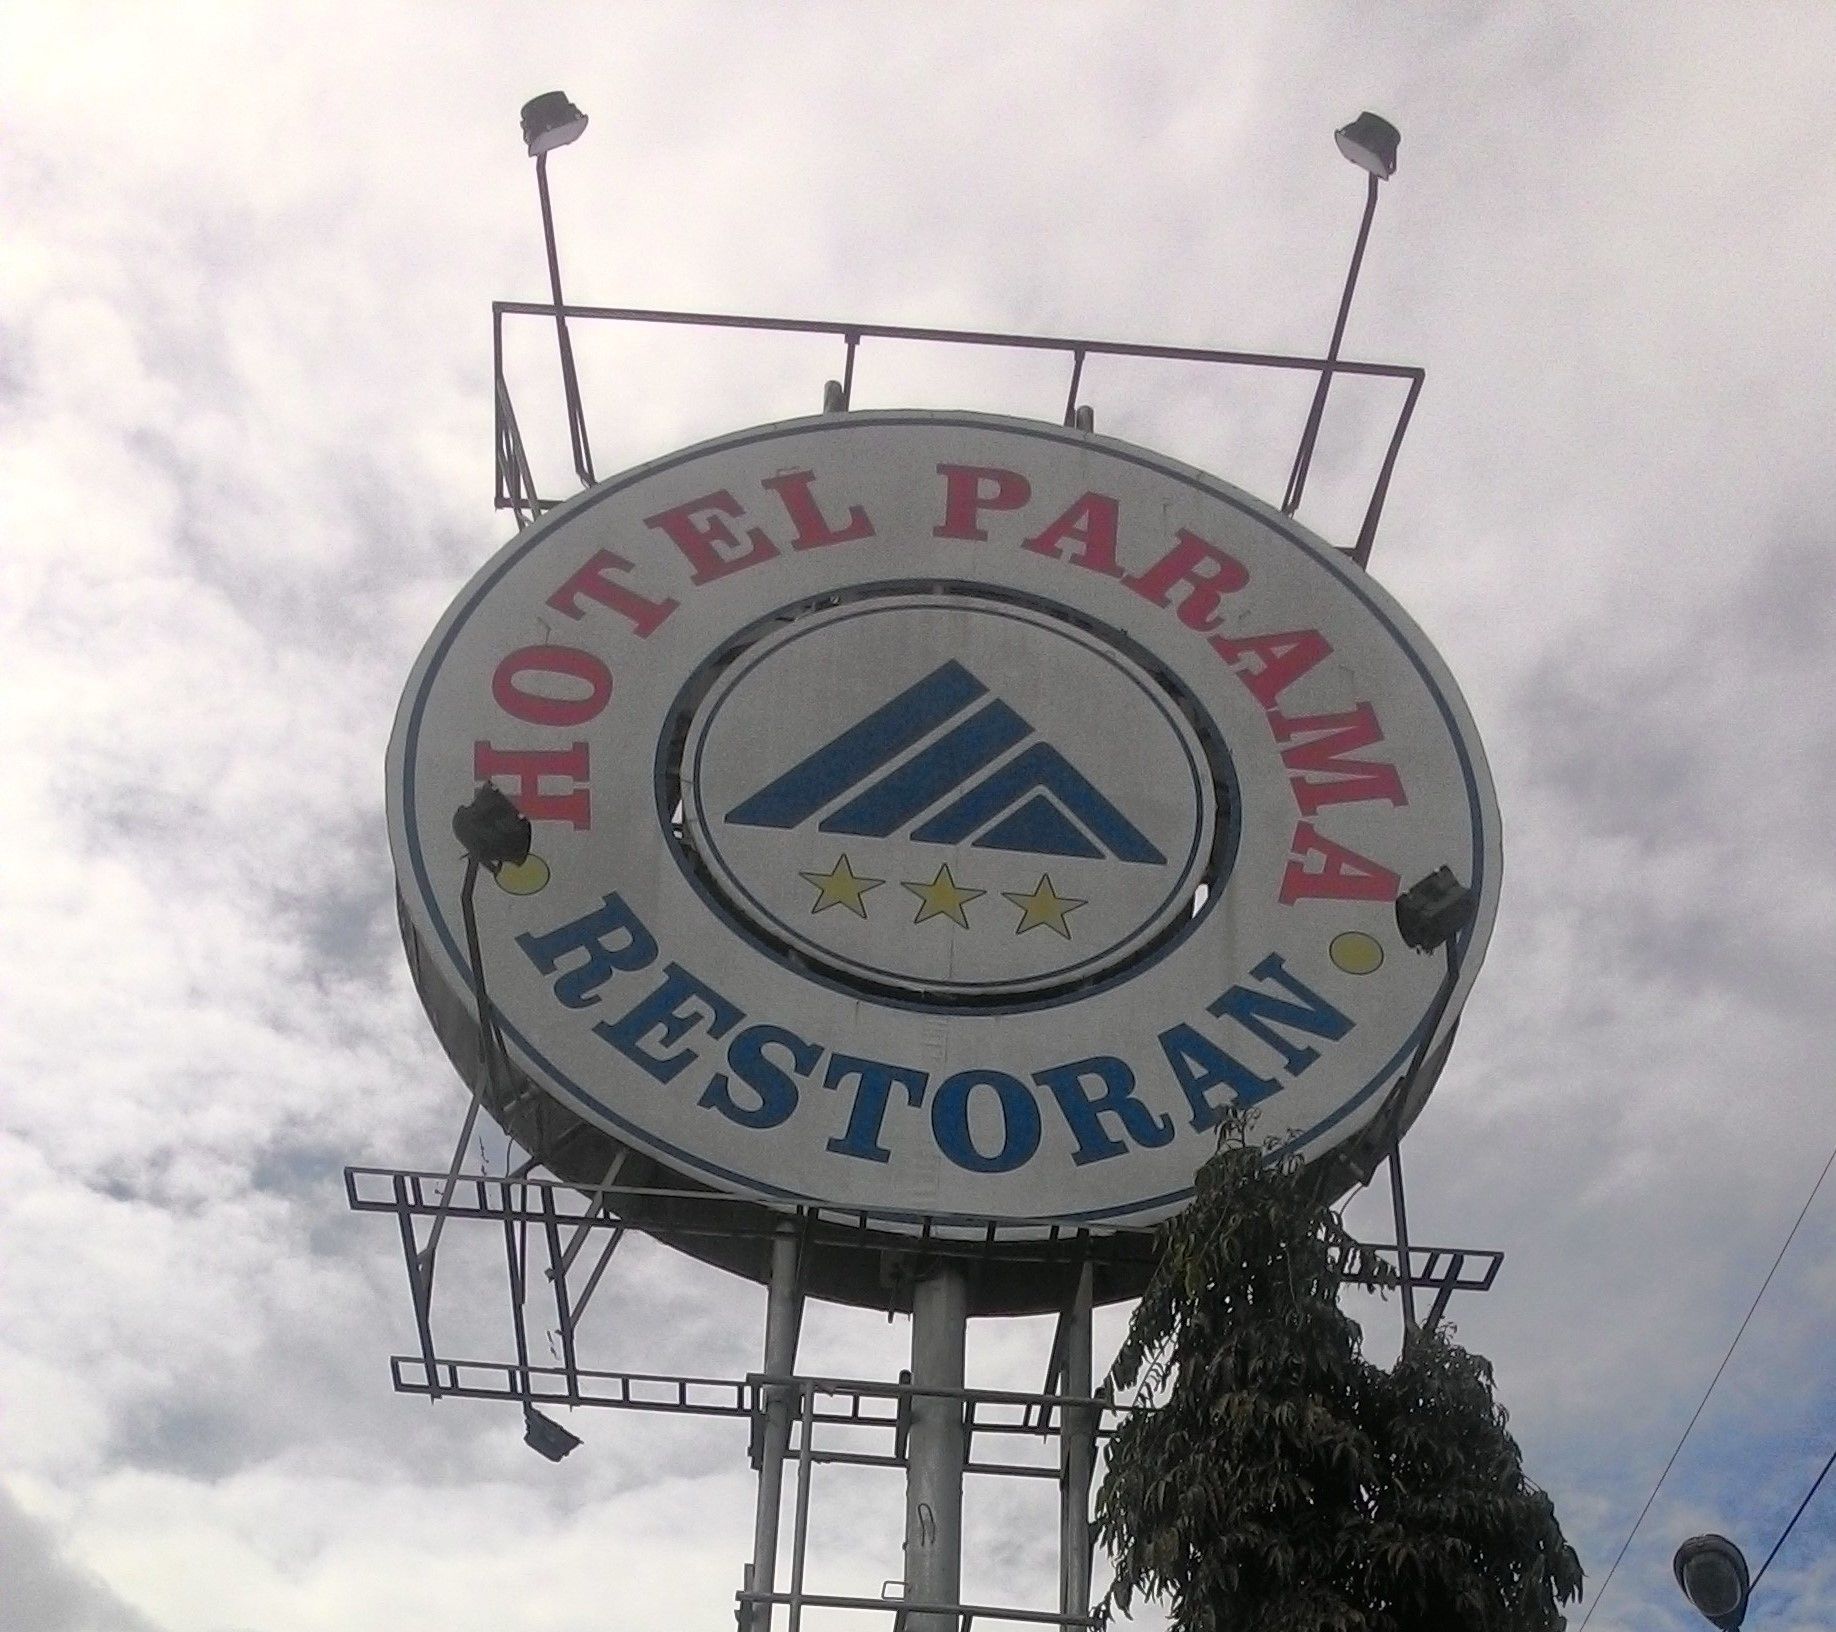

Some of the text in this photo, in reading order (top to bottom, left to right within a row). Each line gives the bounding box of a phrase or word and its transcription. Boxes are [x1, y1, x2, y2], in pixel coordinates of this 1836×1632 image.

[474, 464, 1408, 907] HOTEL PARAMA
[515, 893, 1359, 1174] RESTORAN
